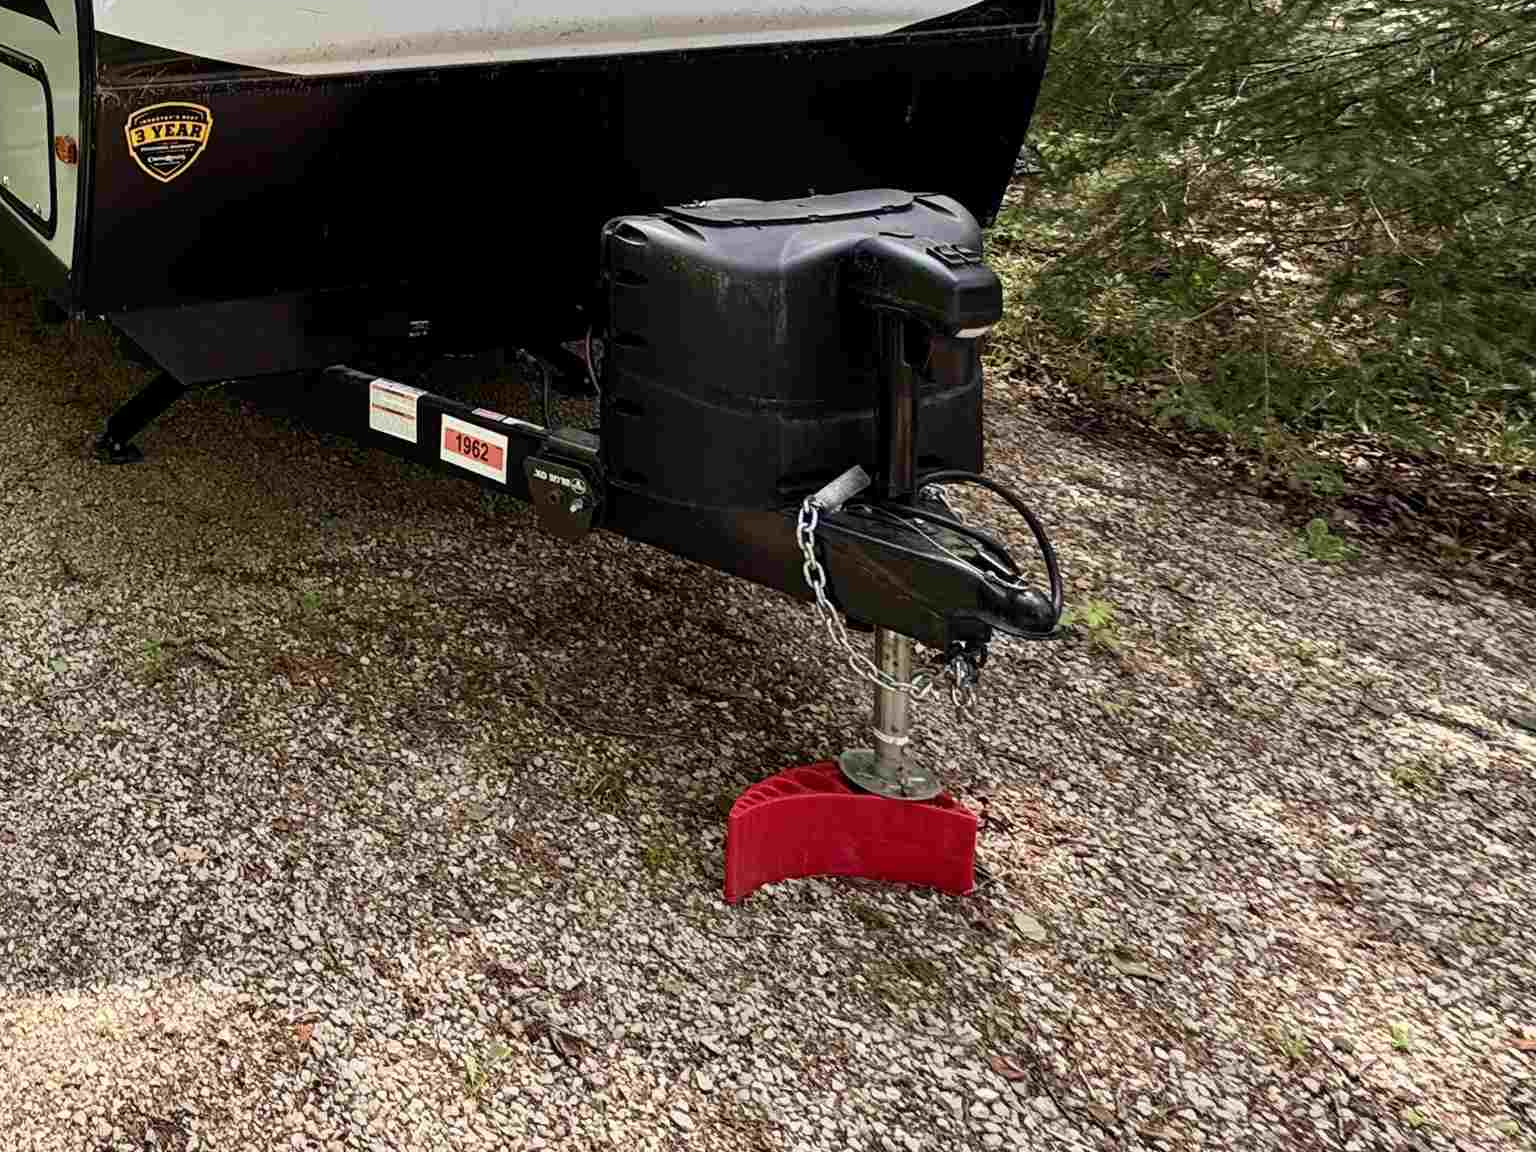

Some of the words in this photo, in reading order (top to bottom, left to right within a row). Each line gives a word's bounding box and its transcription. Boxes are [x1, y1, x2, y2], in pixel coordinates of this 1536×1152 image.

[135, 129, 145, 143] 3
[151, 123, 202, 139] YEAR
[456, 434, 490, 462] 1962
